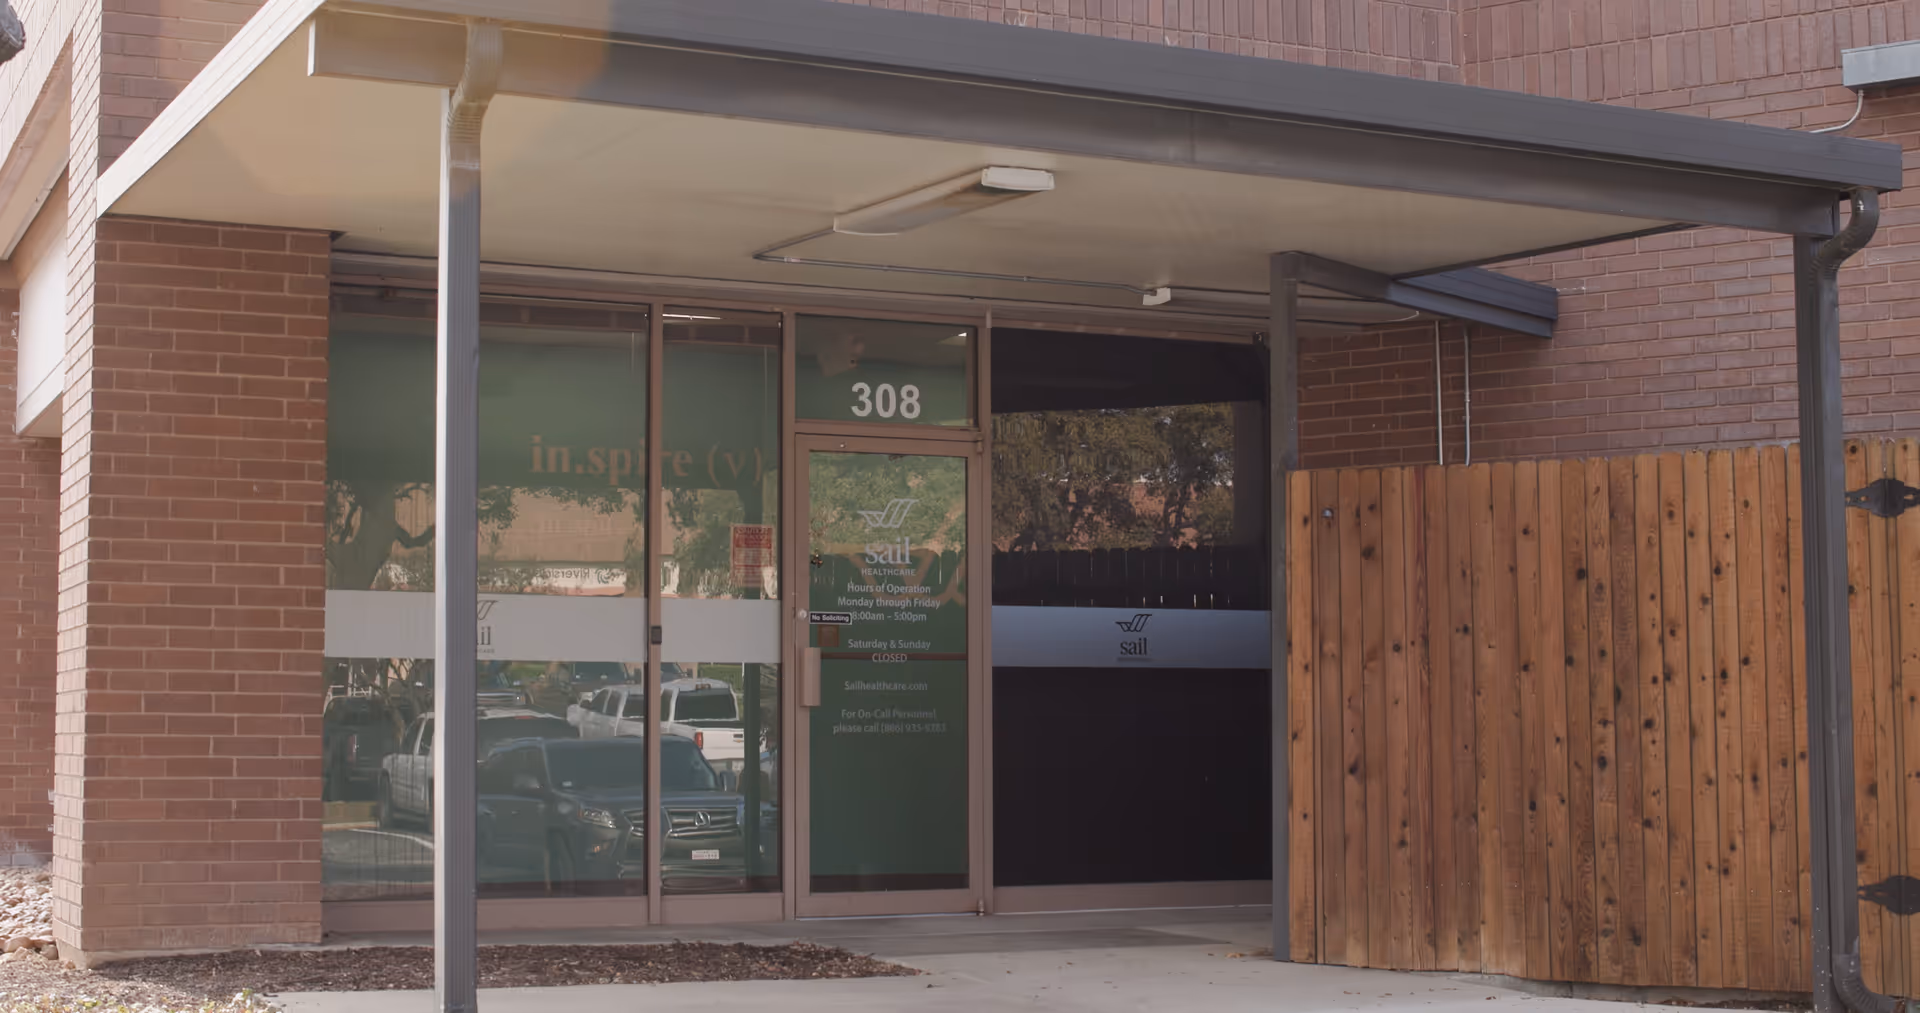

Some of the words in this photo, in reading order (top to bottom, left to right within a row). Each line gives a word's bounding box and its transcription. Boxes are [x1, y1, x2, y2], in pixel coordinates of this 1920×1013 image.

[851, 382, 921, 419] 308
[864, 536, 912, 565] sail
[861, 568, 917, 576] HEALTHCARE
[847, 582, 874, 592] Hours
[876, 583, 885, 592] of
[886, 583, 931, 594] Operation
[837, 597, 874, 608] Monday
[876, 598, 911, 609] through
[913, 599, 941, 610] Friday
[822, 614, 850, 623] Soliciting
[851, 611, 885, 621] 8:00am
[893, 612, 927, 622] 5:00pm
[847, 639, 888, 650] Saturday
[889, 640, 897, 649] &
[898, 640, 931, 650] Sunday
[1120, 637, 1148, 656] sail
[871, 653, 908, 663] CLOSED
[844, 681, 928, 691] Sailhealthcare.com
[841, 709, 856, 719] For
[857, 709, 891, 720] On-Call
[832, 723, 862, 735] please
[863, 723, 879, 733] call
